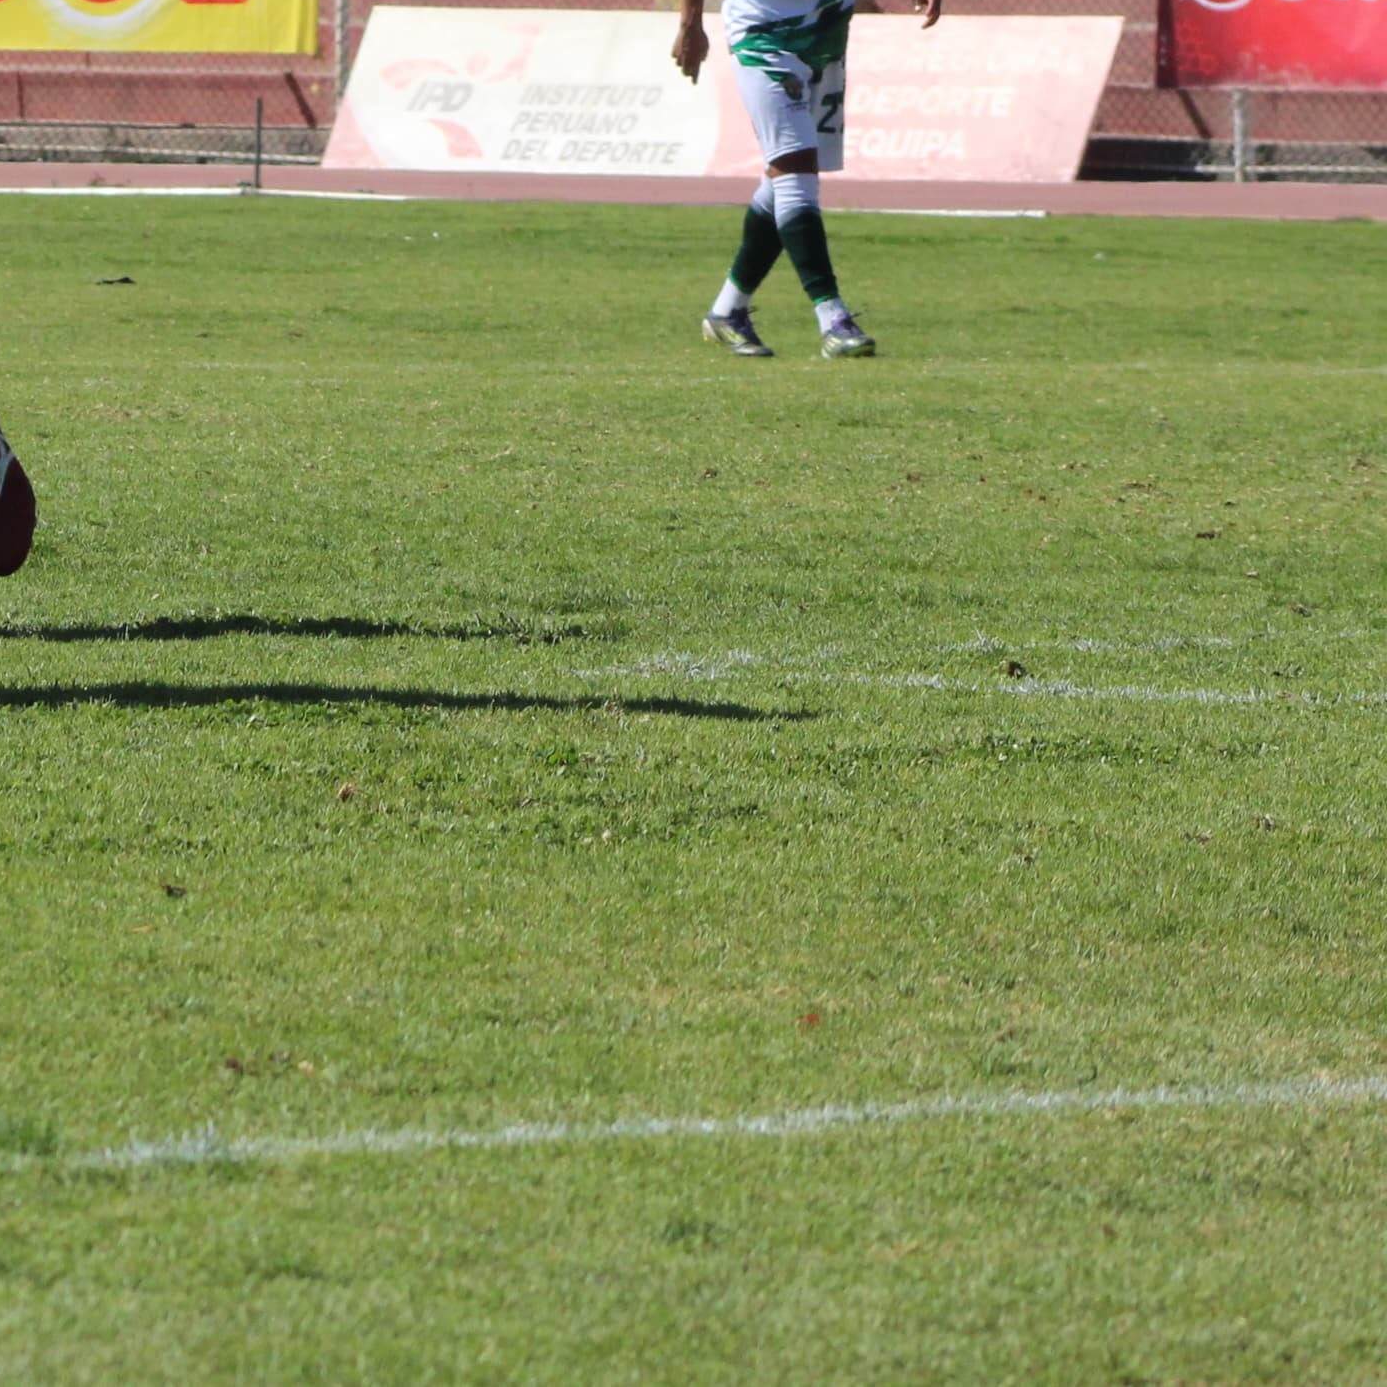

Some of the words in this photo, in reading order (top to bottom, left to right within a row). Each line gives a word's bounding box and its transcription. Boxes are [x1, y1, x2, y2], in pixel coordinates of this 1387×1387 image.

[406, 80, 474, 113] IPD
[518, 83, 664, 107] INSTITUTO
[847, 84, 1017, 119] DEPORTE
[509, 113, 640, 135] PERUANO
[500, 139, 552, 161] DEL
[558, 141, 685, 165] DEPORTE
